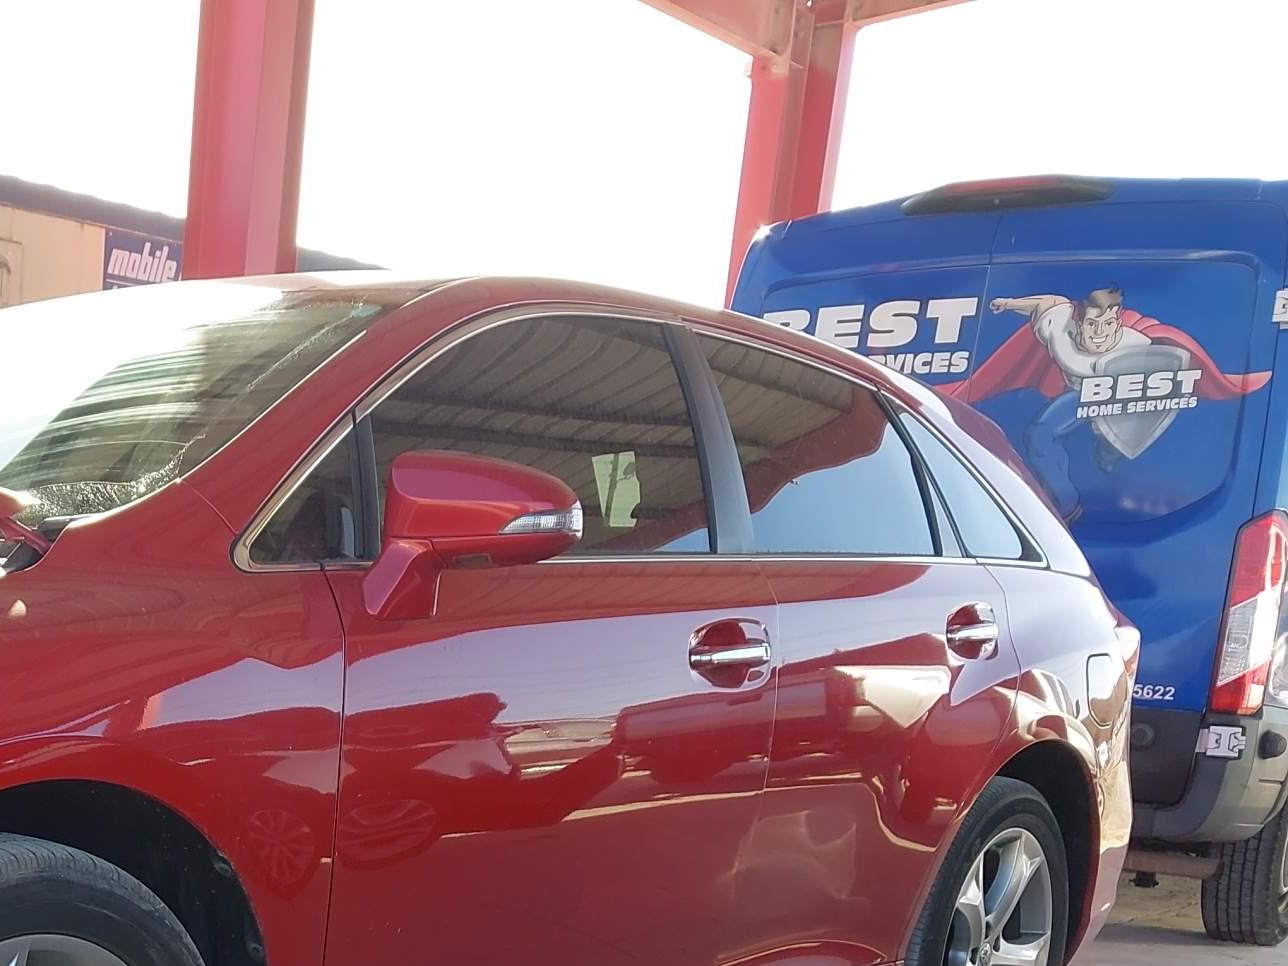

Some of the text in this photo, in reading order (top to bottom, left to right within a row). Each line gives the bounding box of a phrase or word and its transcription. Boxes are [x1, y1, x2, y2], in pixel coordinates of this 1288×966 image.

[107, 242, 178, 283] mobile
[1080, 369, 1202, 402] BEST
[1076, 396, 1198, 418] HOME SERVICES
